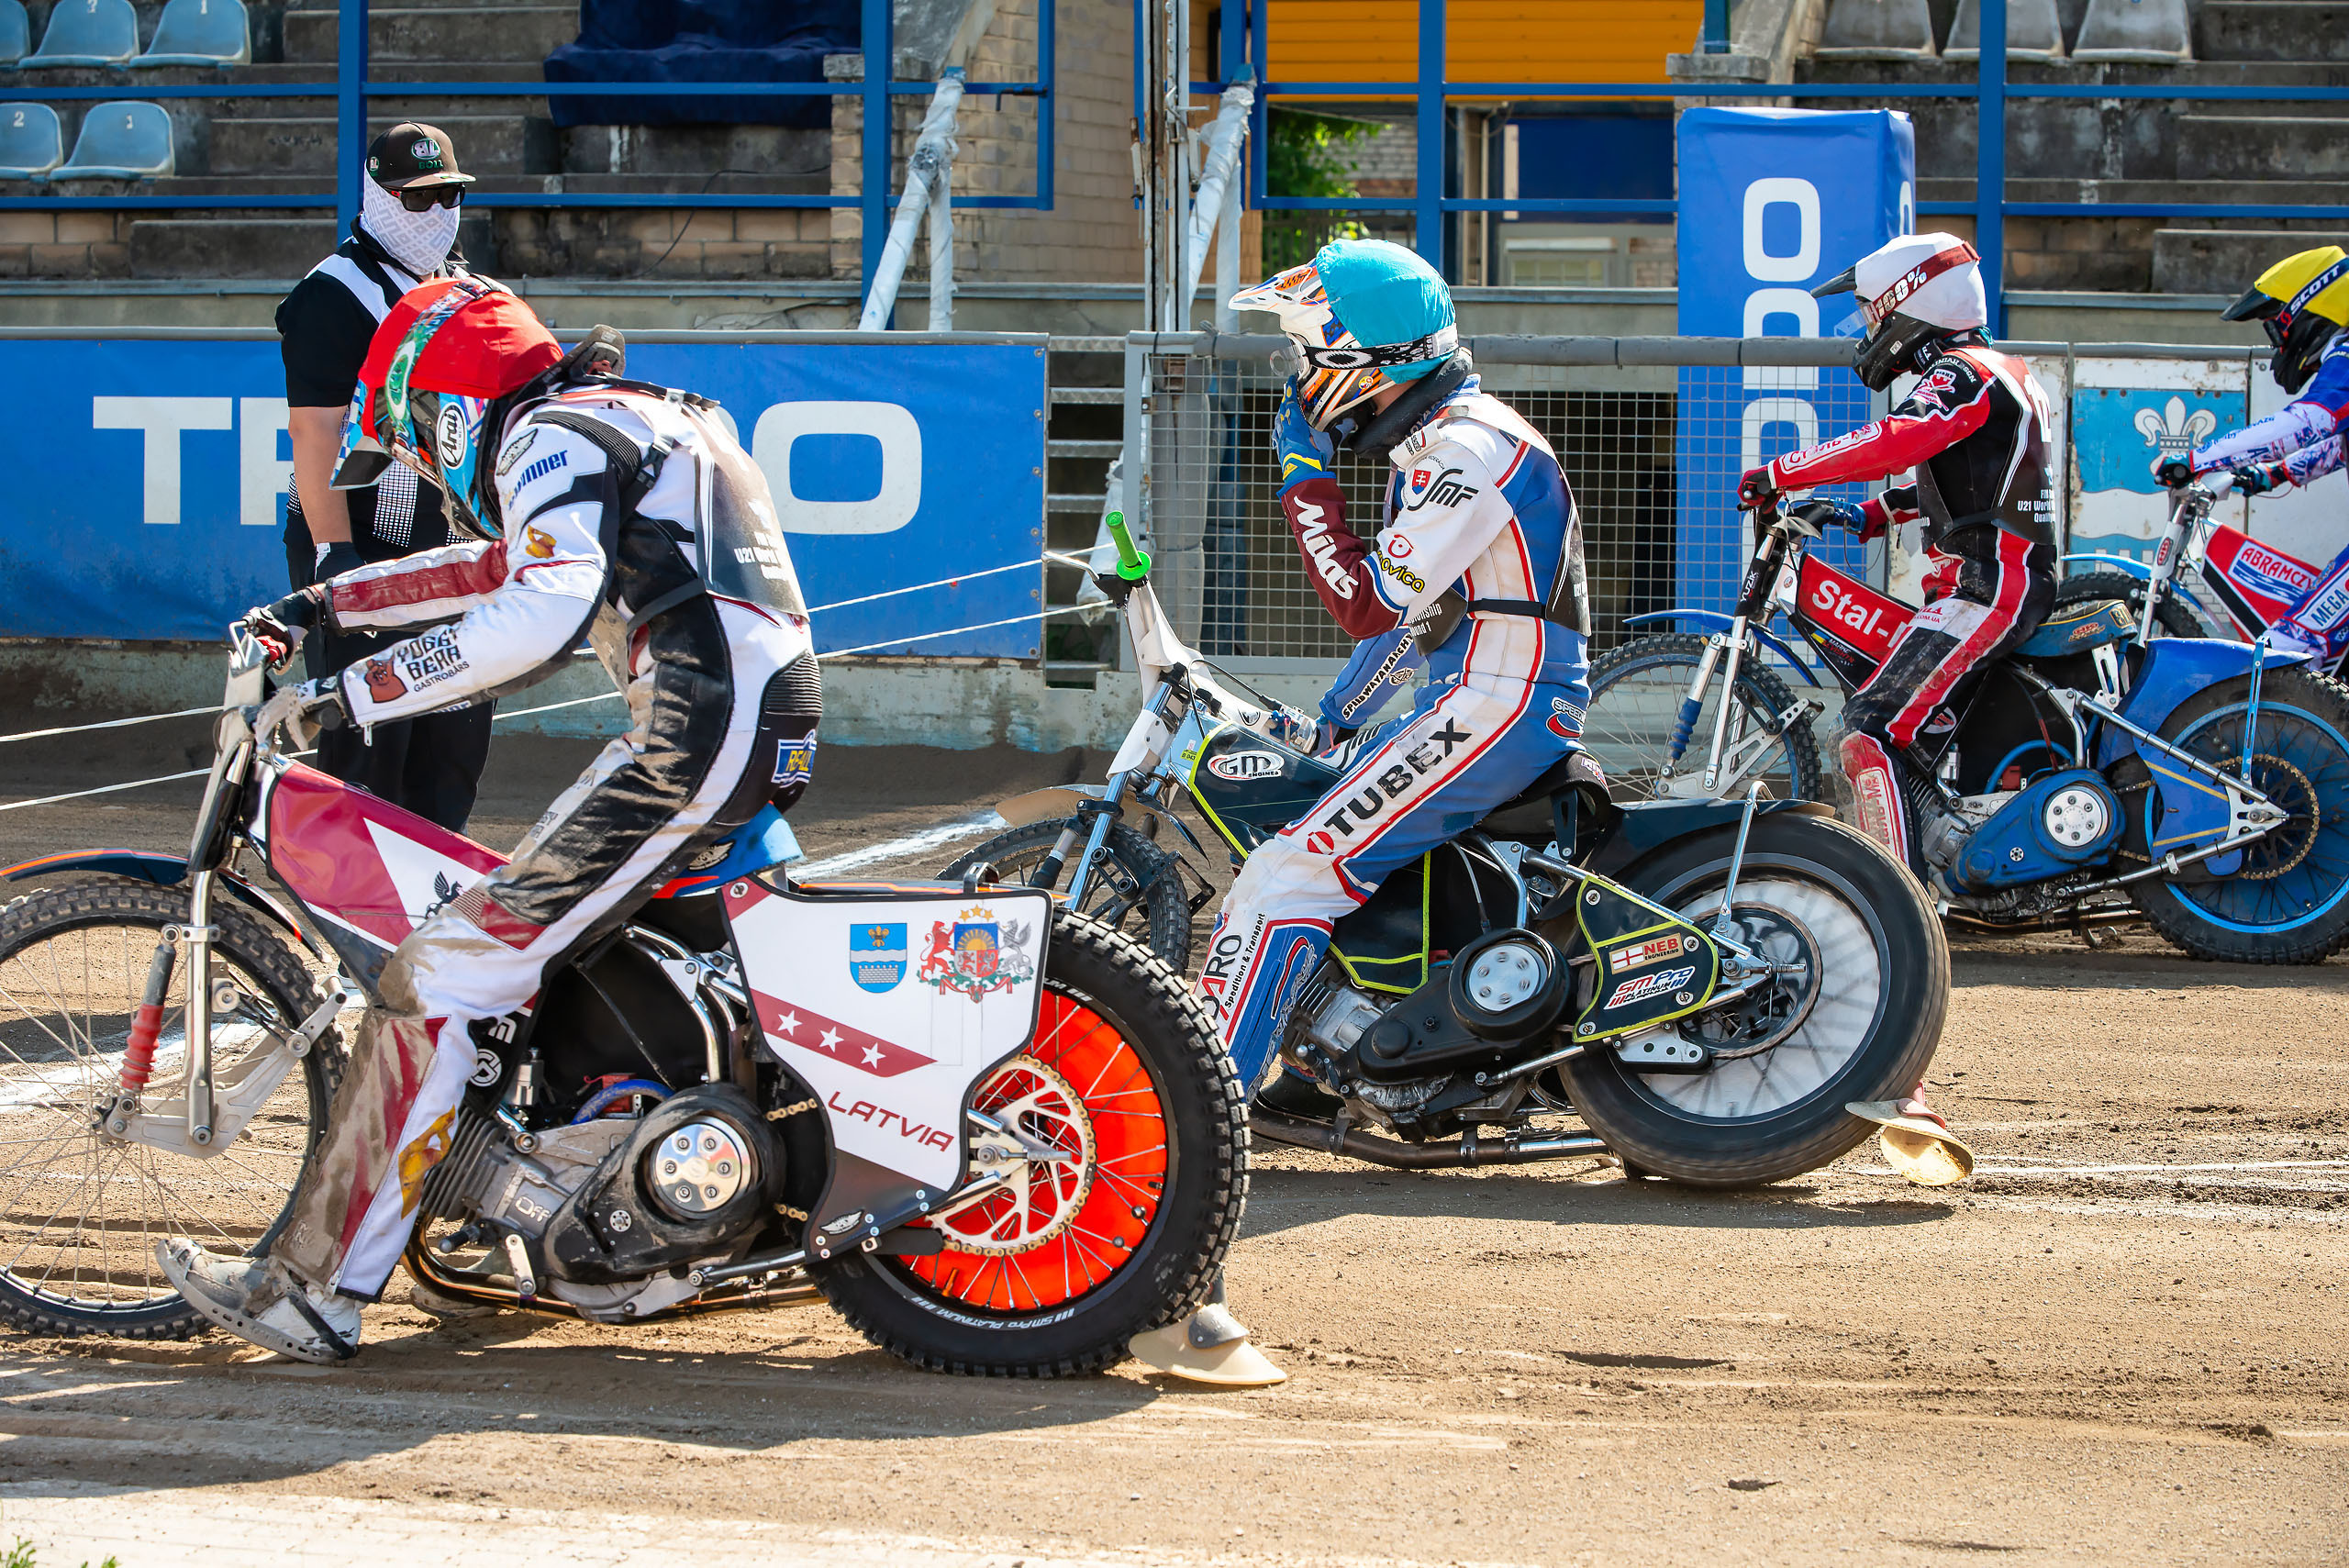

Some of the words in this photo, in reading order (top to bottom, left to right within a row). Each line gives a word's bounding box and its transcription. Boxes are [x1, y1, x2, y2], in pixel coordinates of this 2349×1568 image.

[13, 111, 25, 128] 2
[2290, 264, 2340, 315] SCOTT
[440, 408, 460, 465] Arai
[1407, 469, 1479, 511] SMF
[2018, 501, 2032, 511] U21
[734, 547, 755, 564] U21
[1293, 495, 1359, 600] Milas
[406, 645, 462, 682] BEAR
[1323, 716, 1473, 837] TUBEX
[1244, 913, 1265, 955] Transport
[1644, 938, 1679, 955] NEB
[1241, 953, 1251, 964] &
[1224, 963, 1247, 1008] Spedition
[828, 1091, 955, 1152] LATVIA
[936, 1306, 1003, 1329] PLATINUM
